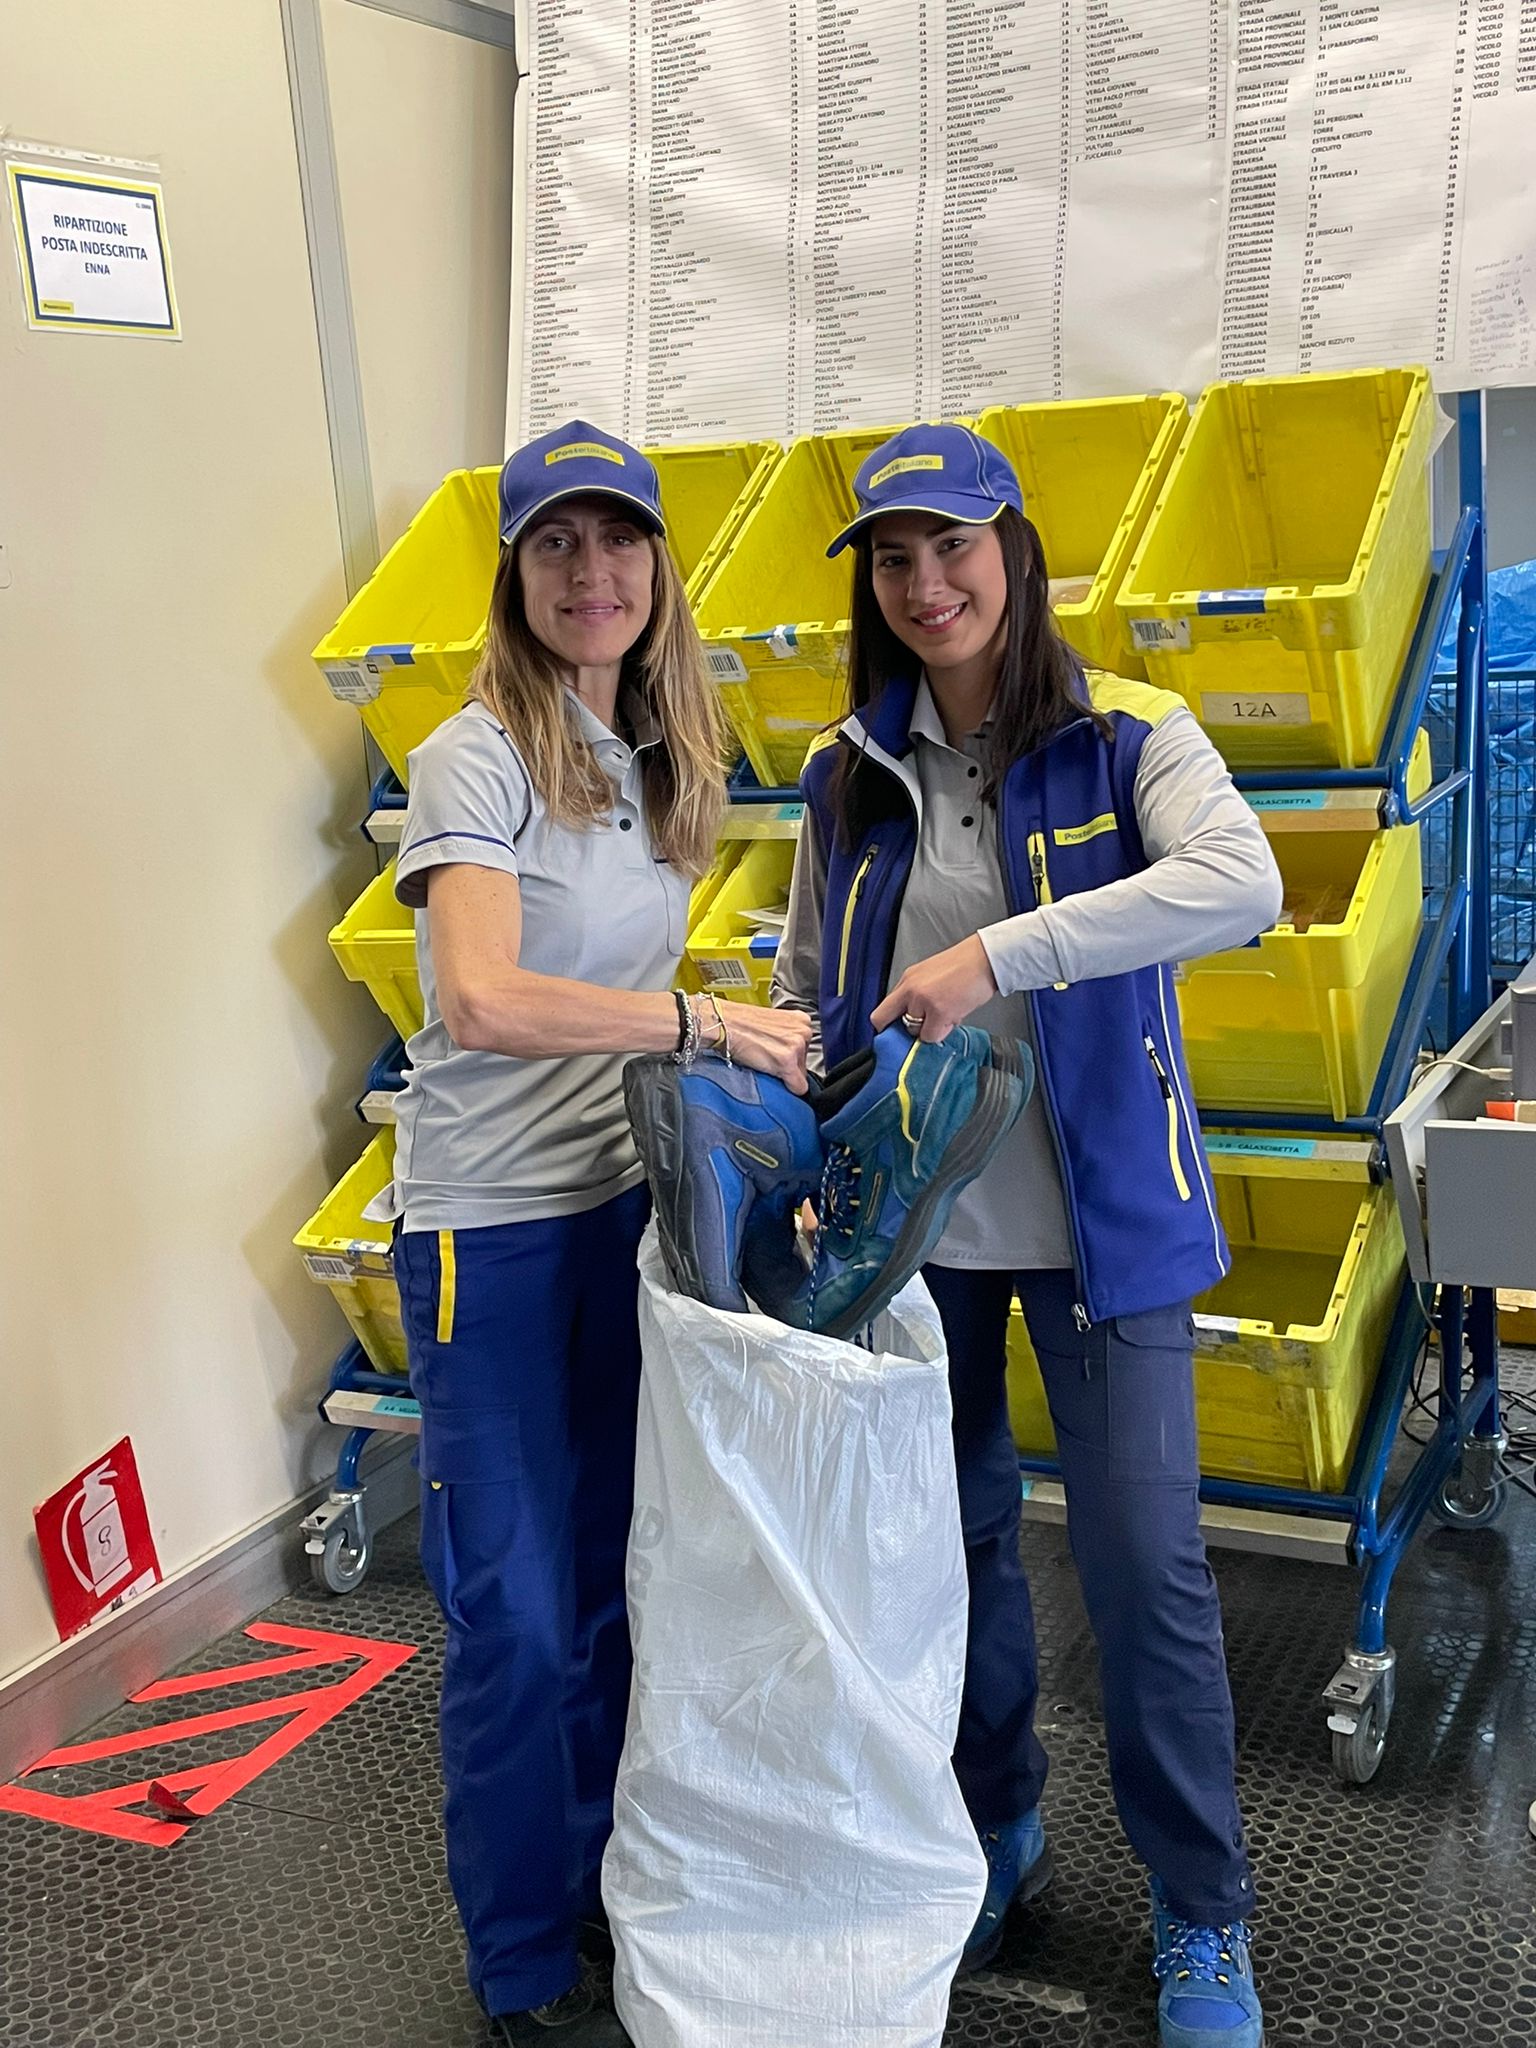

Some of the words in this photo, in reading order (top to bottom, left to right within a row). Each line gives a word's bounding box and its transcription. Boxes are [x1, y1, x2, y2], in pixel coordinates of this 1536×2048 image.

[1478, 13, 1504, 23] VICOLO
[1476, 42, 1502, 52] VICOLO
[1472, 90, 1498, 100] VICOLO
[53, 214, 128, 236] RIPARTIZIONE
[41, 236, 78, 253] POSTA
[79, 241, 148, 261] INDESCRITTA
[85, 262, 110, 275] ENNA
[1232, 702, 1277, 718] 12A
